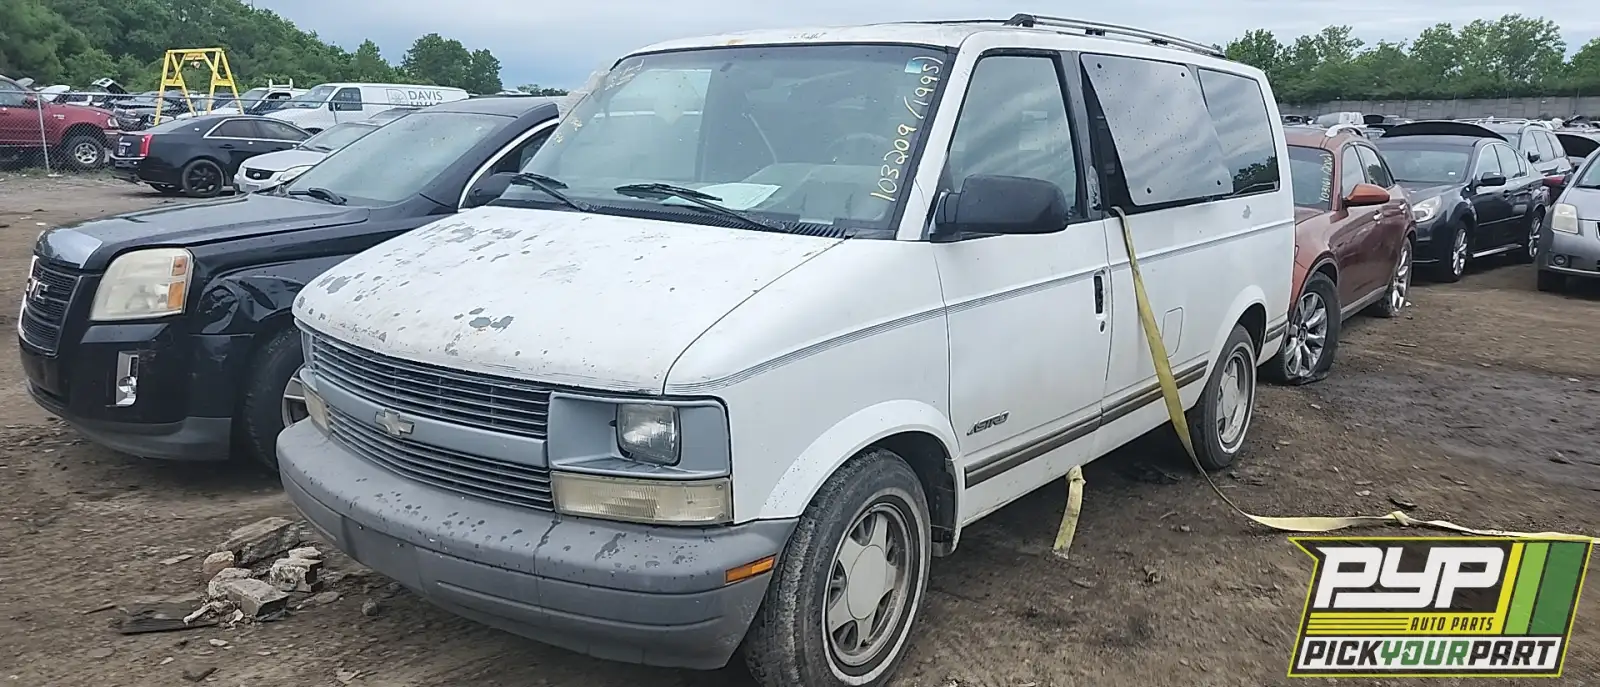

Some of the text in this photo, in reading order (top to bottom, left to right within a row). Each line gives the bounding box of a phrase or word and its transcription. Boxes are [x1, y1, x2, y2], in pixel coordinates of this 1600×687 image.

[407, 91, 443, 101] DAVIS
[870, 56, 944, 201] 103209 (1995)
